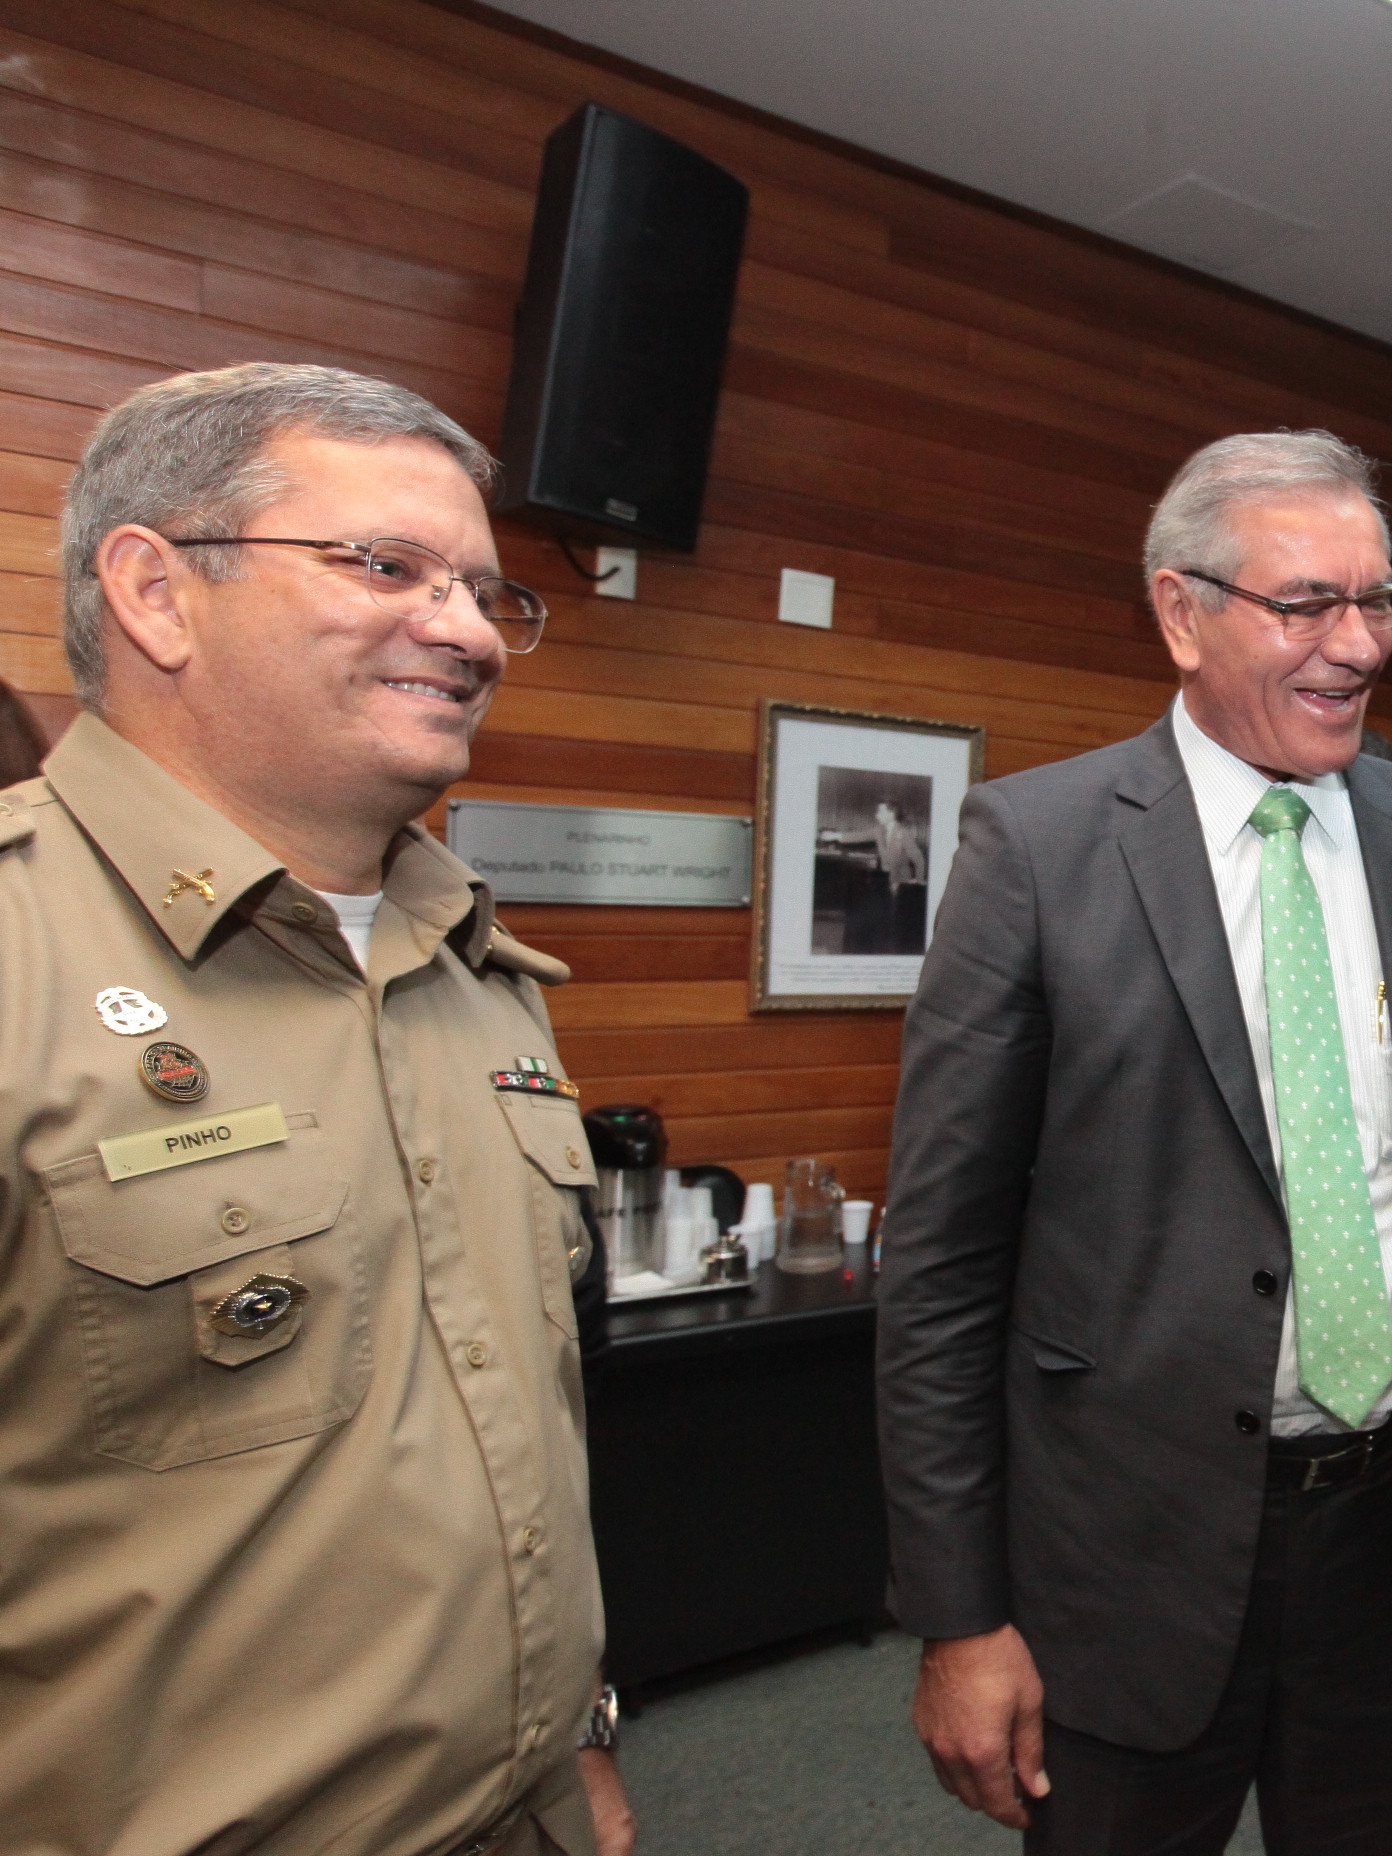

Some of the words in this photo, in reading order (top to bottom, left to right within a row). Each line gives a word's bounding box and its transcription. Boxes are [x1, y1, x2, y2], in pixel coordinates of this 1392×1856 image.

[471, 857, 547, 875] Deputado
[549, 860, 603, 876] PAULO
[607, 862, 668, 877] STUART
[672, 865, 731, 879] WRIGHT
[164, 1126, 231, 1153] PINHO
